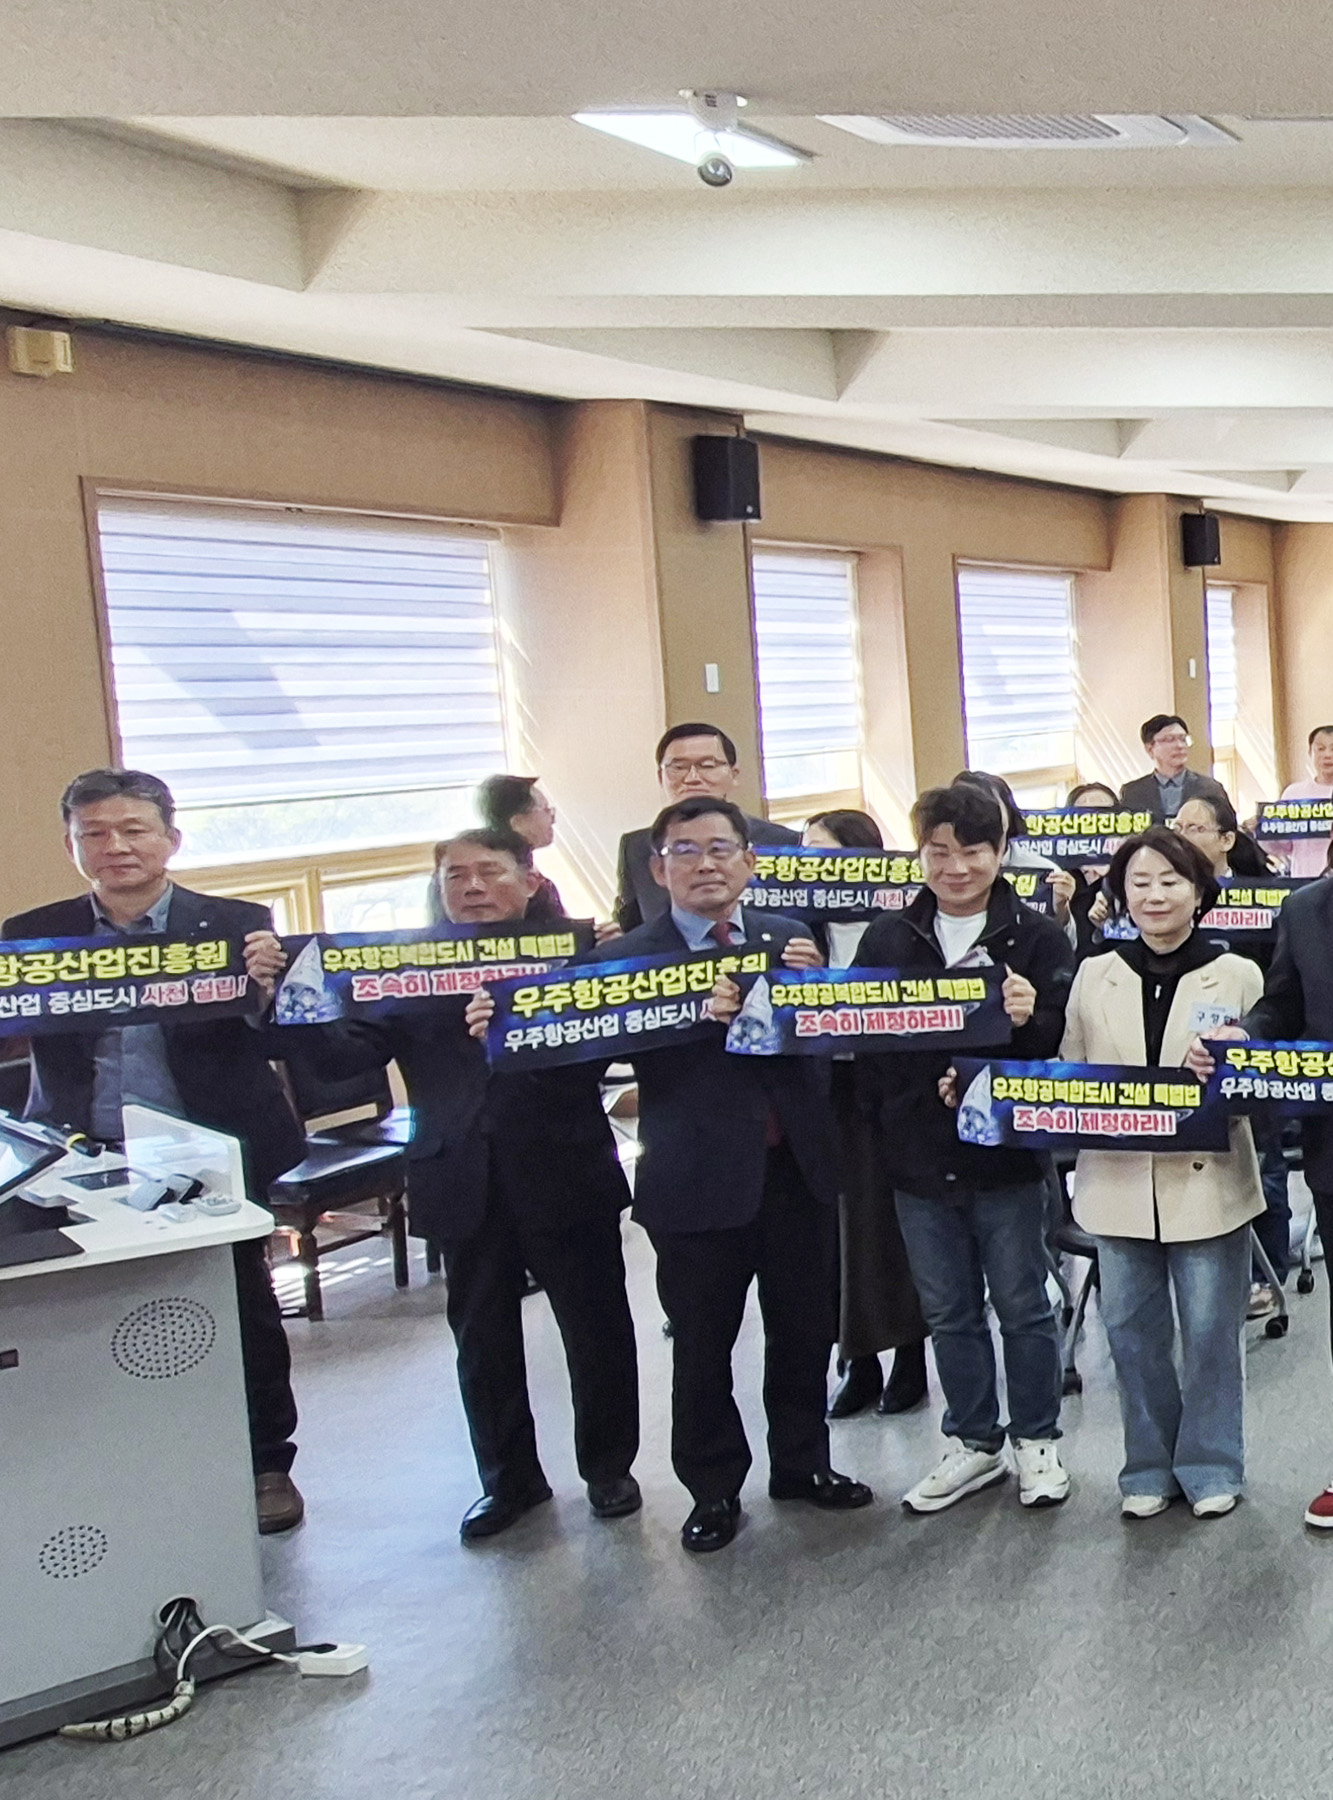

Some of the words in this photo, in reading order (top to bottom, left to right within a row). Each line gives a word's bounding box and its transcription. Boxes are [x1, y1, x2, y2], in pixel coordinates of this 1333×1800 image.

[48, 985, 137, 1013] 중심도시
[504, 1013, 619, 1052] 우주항공산업
[625, 1002, 696, 1033] 중심도시
[795, 1009, 861, 1037] 조속히
[1219, 1077, 1317, 1101] 우주항공산업
[1012, 1105, 1077, 1133] 조속히
